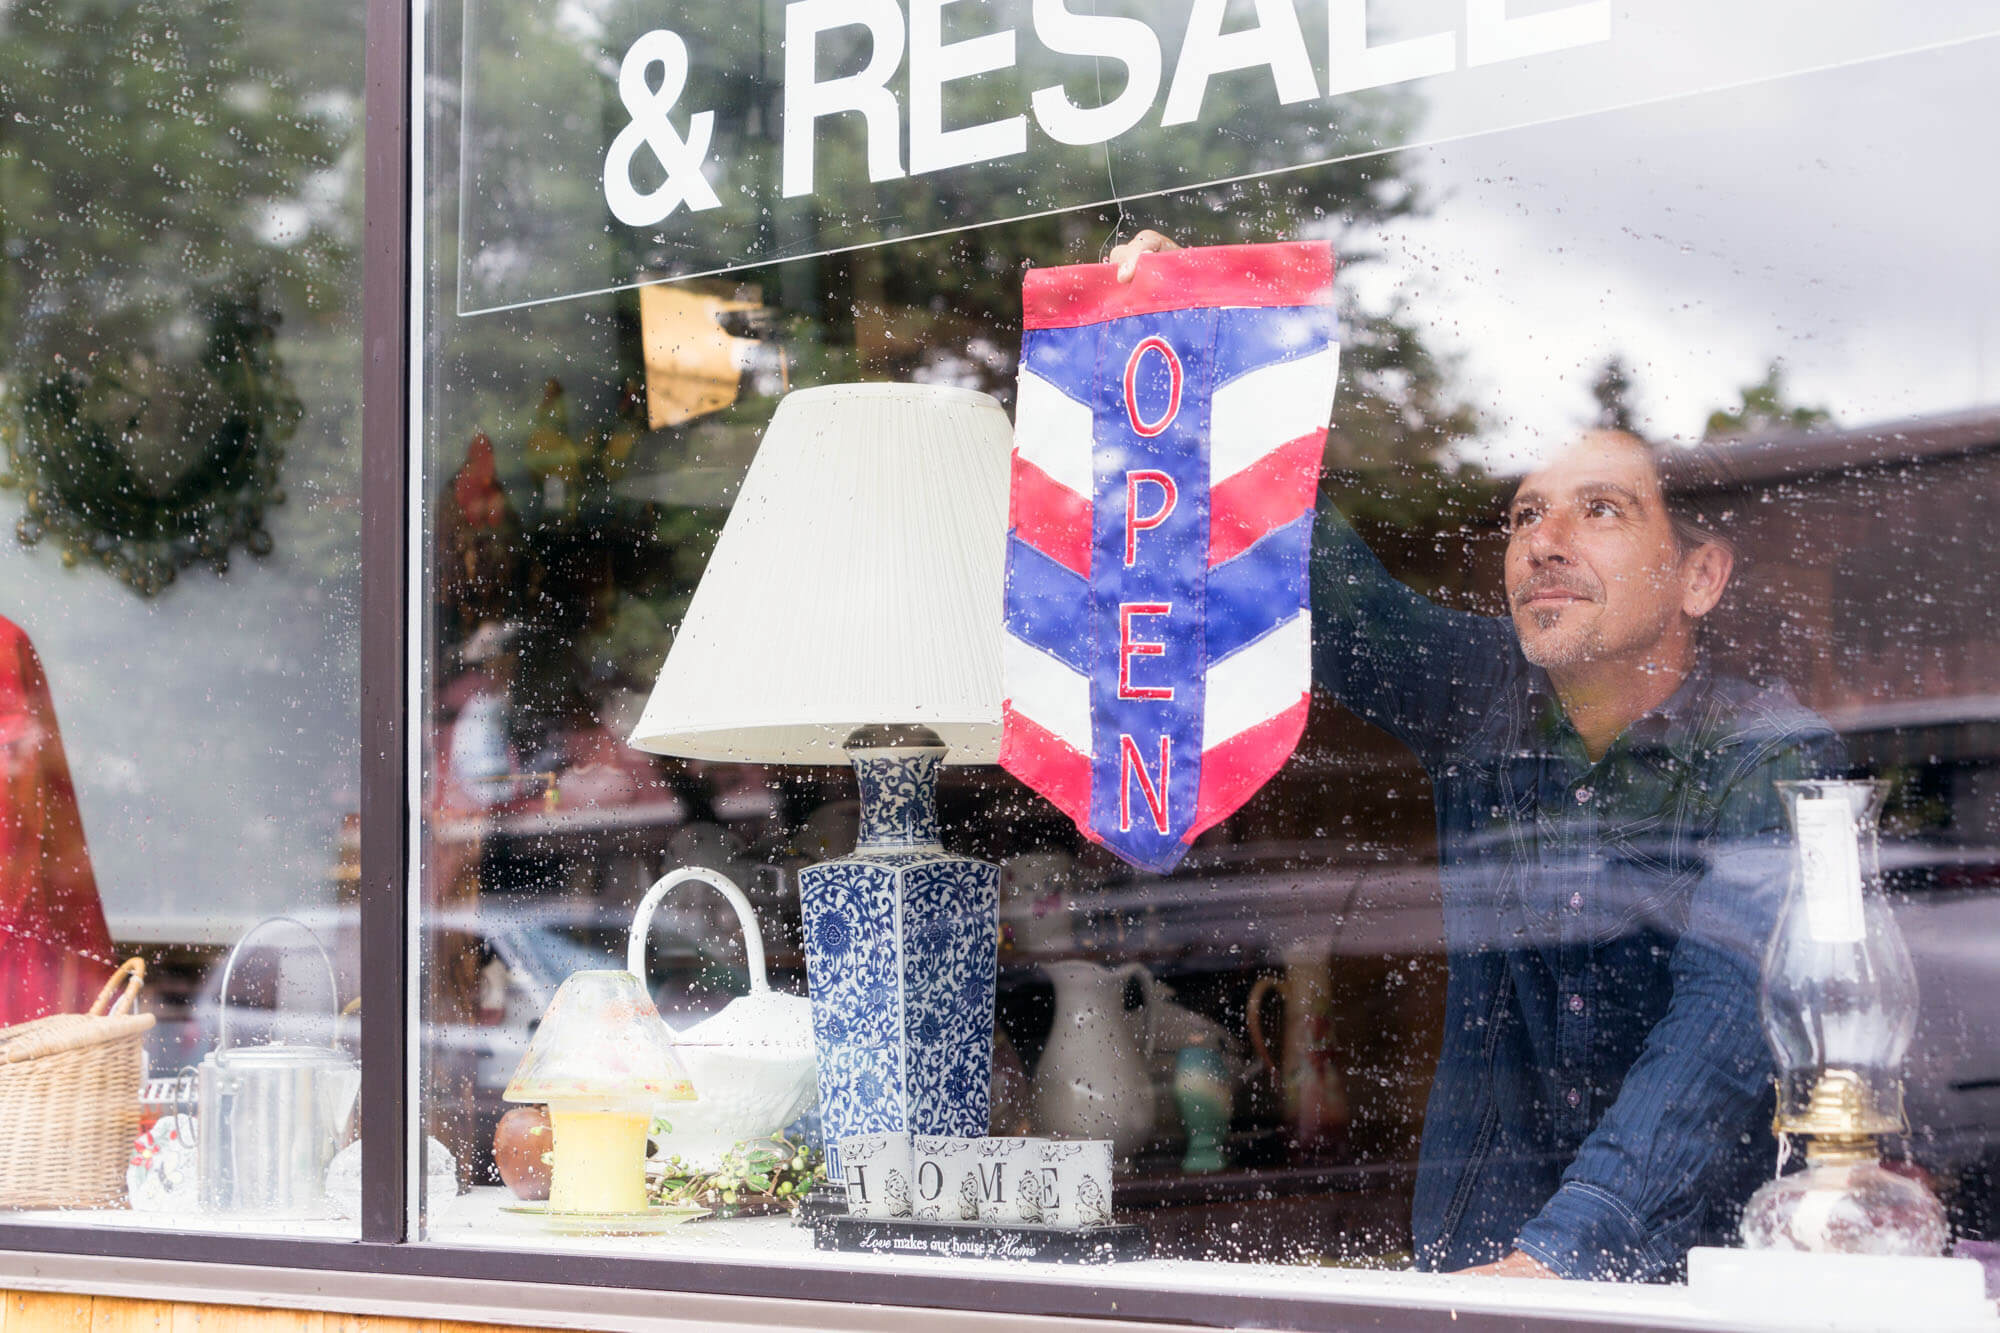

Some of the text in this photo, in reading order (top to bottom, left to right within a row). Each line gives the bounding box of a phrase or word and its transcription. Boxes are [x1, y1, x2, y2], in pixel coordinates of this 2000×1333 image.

[603, 29, 723, 227] &
[1118, 335, 1184, 836] OPEN
[844, 1160, 1061, 1209] HOME
[860, 1228, 892, 1249] Love
[893, 1233, 928, 1250] makes
[930, 1240, 950, 1251] our
[951, 1237, 986, 1254] house
[997, 1233, 1037, 1257] Home
